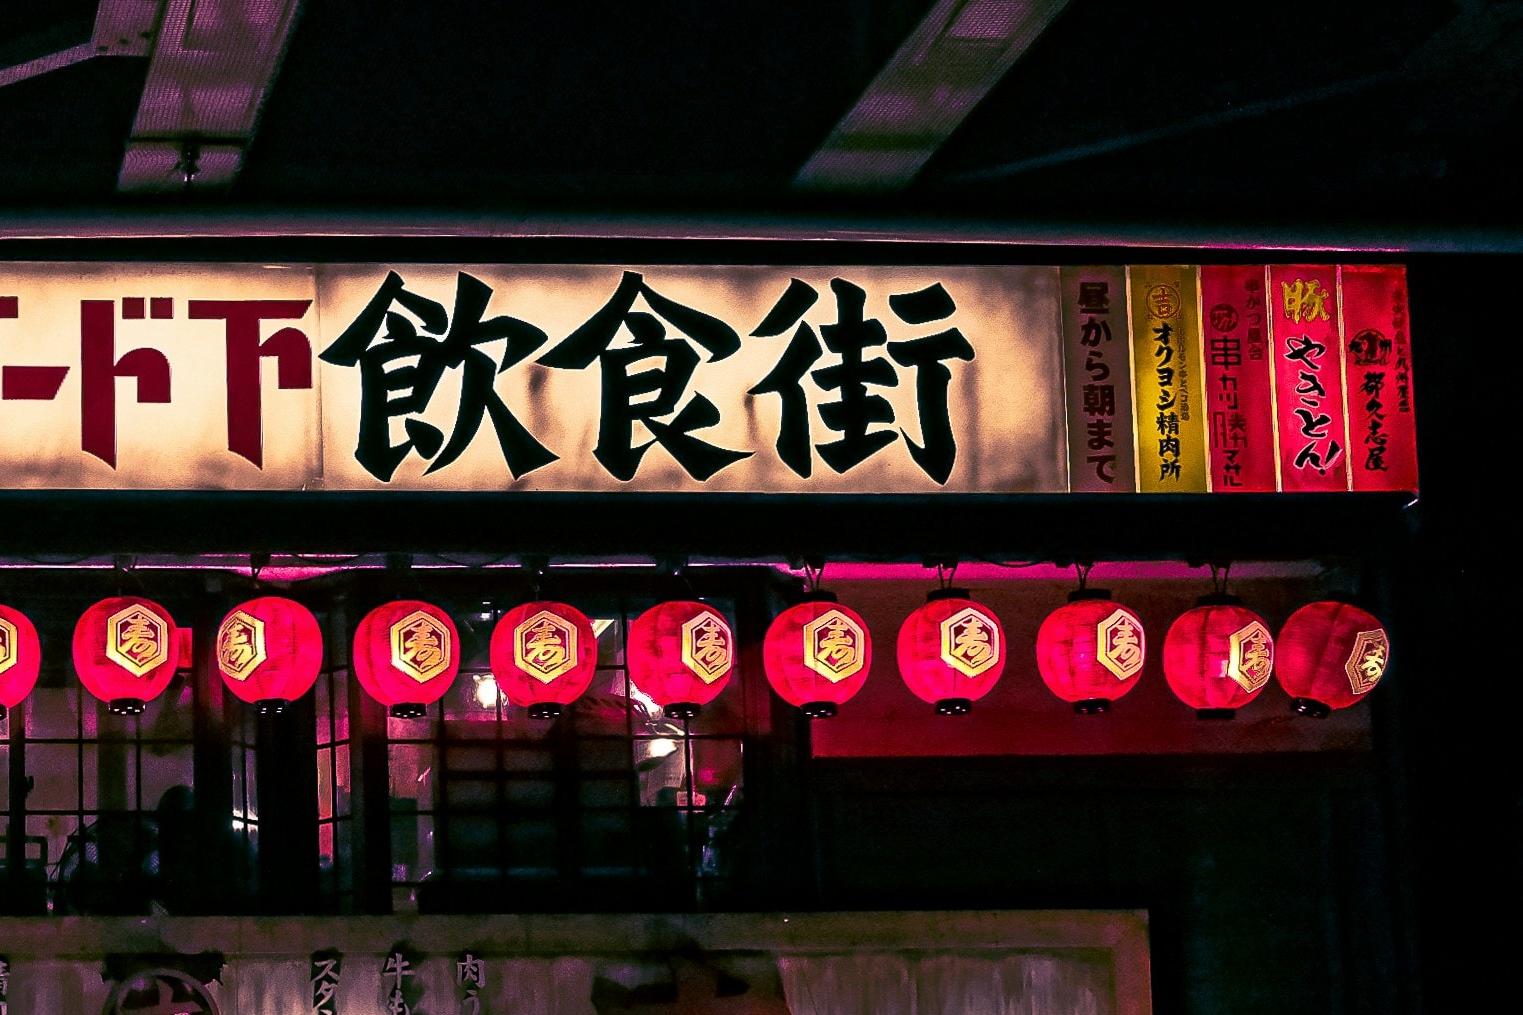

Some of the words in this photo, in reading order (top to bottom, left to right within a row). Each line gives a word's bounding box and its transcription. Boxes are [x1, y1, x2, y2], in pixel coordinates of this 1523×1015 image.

[1245, 279, 1262, 361] 串かつ屋台
[1280, 279, 1330, 324] 豚
[1076, 282, 1117, 484] 昼から朝まで
[1154, 322, 1182, 482] オクヨシ精肉所
[1284, 334, 1344, 476] やきとん!
[1358, 372, 1387, 471] 都久志屋
